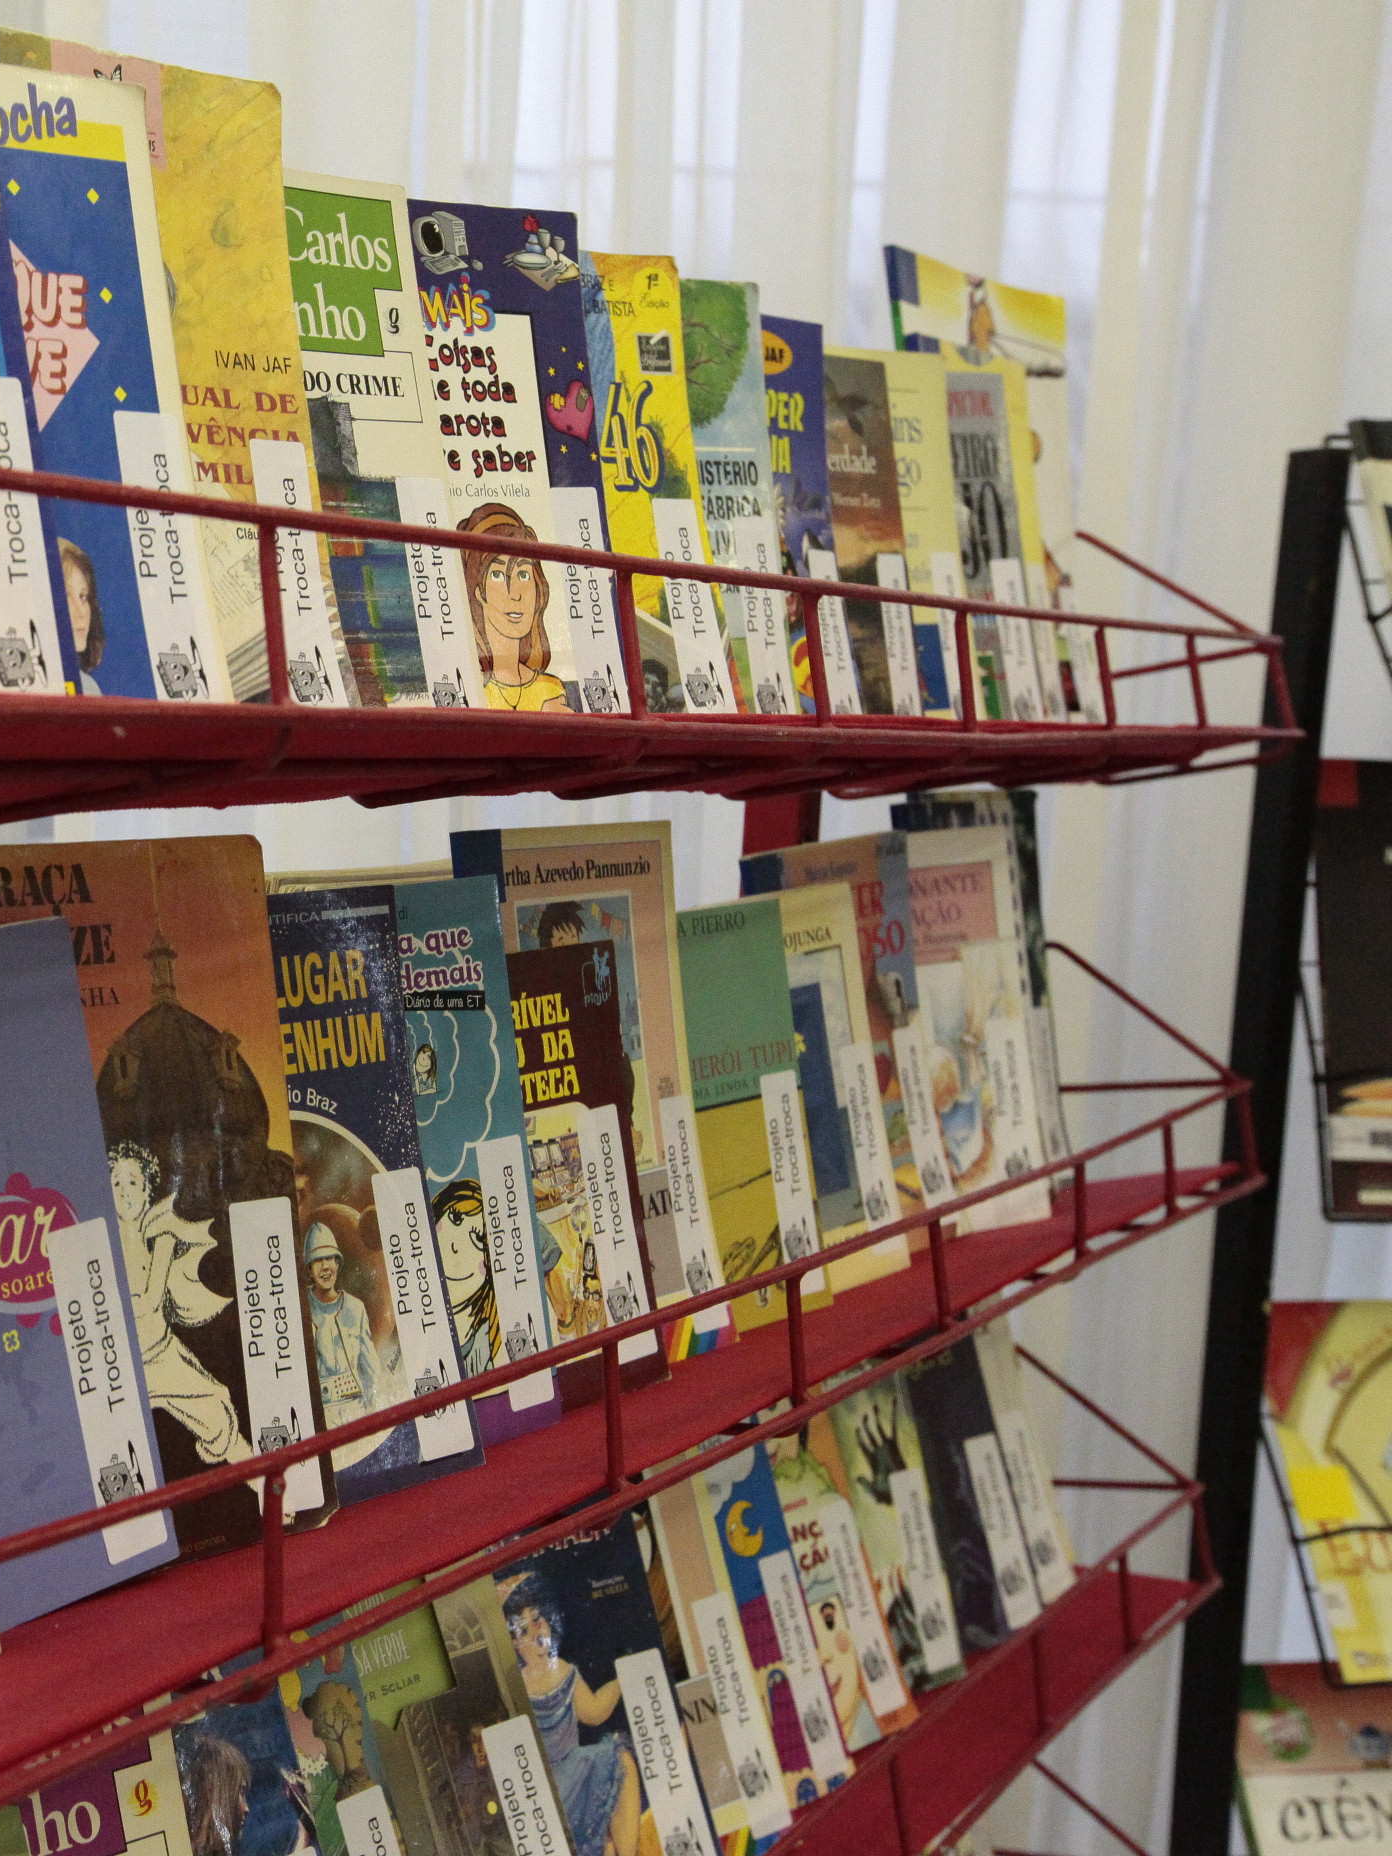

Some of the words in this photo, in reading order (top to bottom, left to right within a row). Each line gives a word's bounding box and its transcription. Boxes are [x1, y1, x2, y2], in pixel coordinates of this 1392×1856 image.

[284, 206, 392, 273] Carlos
[214, 350, 256, 371] IVAN
[263, 356, 292, 375] JAF
[335, 373, 406, 398] CRIME
[461, 373, 518, 404] toda
[255, 391, 299, 415] DE
[439, 412, 507, 438] arota
[465, 483, 498, 497] Carlos
[499, 483, 530, 498] Vilela
[471, 443, 537, 479] saber
[132, 490, 158, 580] Proje
[153, 453, 188, 605] Troca-tca
[283, 477, 312, 617] Troca-tca
[410, 542, 432, 619] Projeto
[425, 511, 455, 641] Troca-troa
[565, 555, 585, 620] Proje
[579, 518, 605, 639] Troca-tca
[664, 550, 685, 620] Projo
[679, 526, 706, 639] Trocaoca
[743, 565, 759, 633] Projeo
[758, 542, 777, 650] Troca-oca
[534, 861, 585, 885] Azevedo
[586, 855, 651, 880] Pannunzio
[277, 950, 369, 1009] UGAR
[424, 927, 473, 957] que
[540, 1028, 576, 1064] DA
[306, 1085, 338, 1115] Braz
[503, 1165, 527, 1290] Troca-troca
[586, 1162, 606, 1235] Projeto
[599, 1131, 626, 1250] Troca-troca
[404, 1201, 437, 1334] Troca-troca
[487, 1194, 507, 1274] Projeto
[244, 1268, 266, 1358] Projeto
[266, 1234, 292, 1379] Troca-troca
[389, 1233, 413, 1316] Projeto
[67, 1299, 97, 1396] Projeto
[87, 1258, 125, 1413] Troca-troca
[380, 1673, 421, 1697] SCLIAR
[631, 1704, 658, 1781] Projeto
[644, 1675, 683, 1796] Troca-troca
[501, 1777, 531, 1856] Projeto
[513, 1743, 555, 1856] roca-troca
